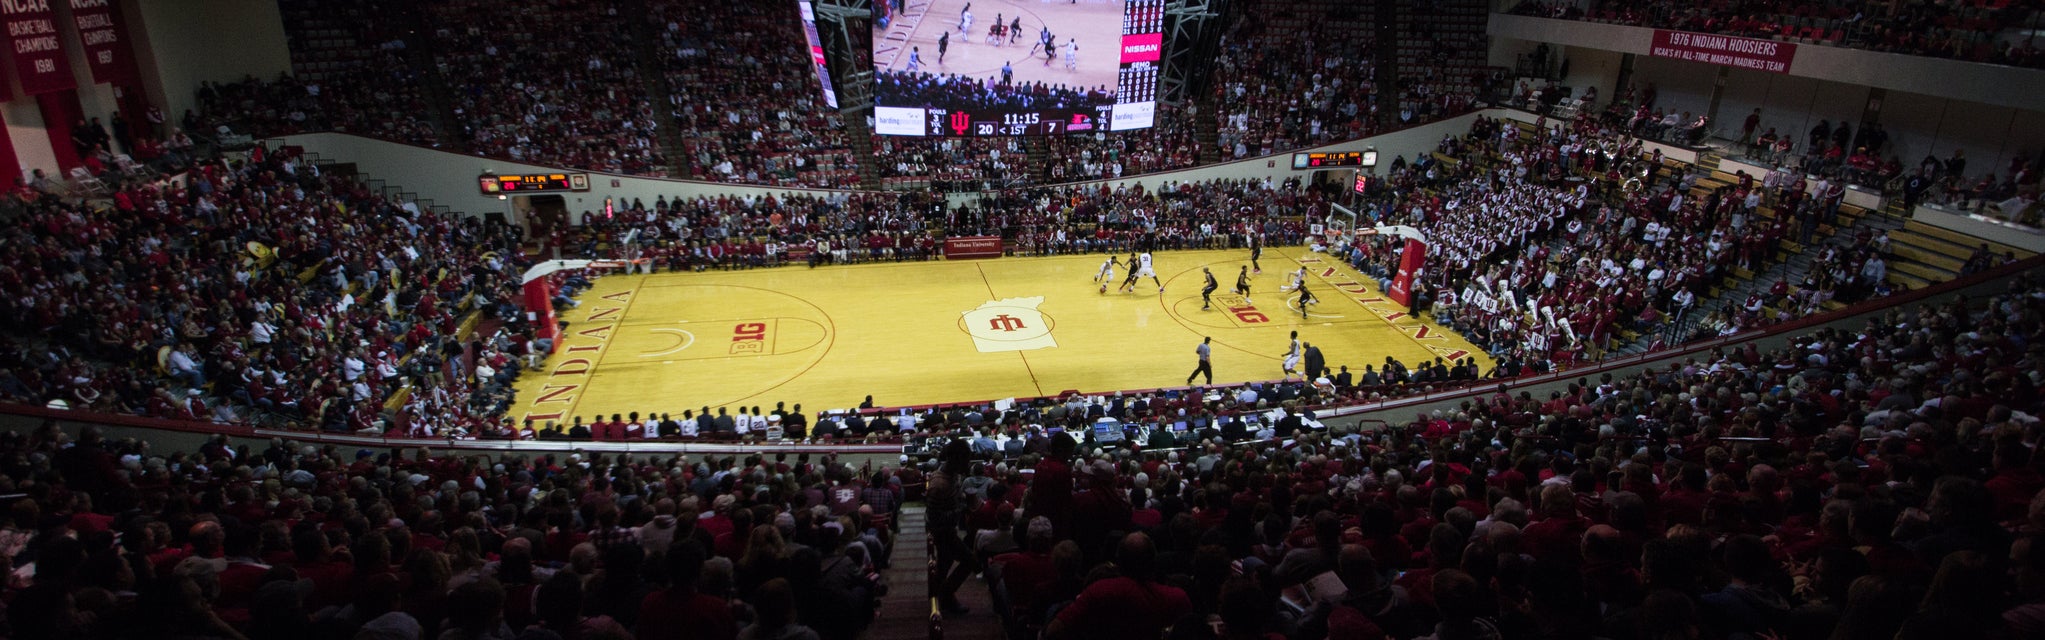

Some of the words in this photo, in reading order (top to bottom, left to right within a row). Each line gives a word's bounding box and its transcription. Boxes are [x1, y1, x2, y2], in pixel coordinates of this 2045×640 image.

[8, 19, 56, 36] BASKETBALL
[15, 36, 59, 53] CHAMPIONS
[1124, 44, 1158, 53] NISSAN
[1669, 32, 1690, 46] 1976
[1691, 34, 1728, 50] INDIANA
[1728, 38, 1778, 56] HOOSIERS
[34, 58, 56, 73] 1981
[1132, 61, 1150, 69] SEMO
[1654, 47, 1674, 58] NCAA'S
[1682, 50, 1710, 62] ALL-TIME
[1710, 54, 1734, 65] MARCH
[1733, 56, 1766, 70] MADNESS
[1765, 60, 1785, 72] TEAM
[1004, 113, 1039, 124] 11:15
[978, 124, 993, 134] 20
[1010, 125, 1026, 134] 1ST
[1048, 122, 1056, 132] 7
[1297, 256, 1470, 363] INDIANA
[522, 289, 634, 425] INDIANA
